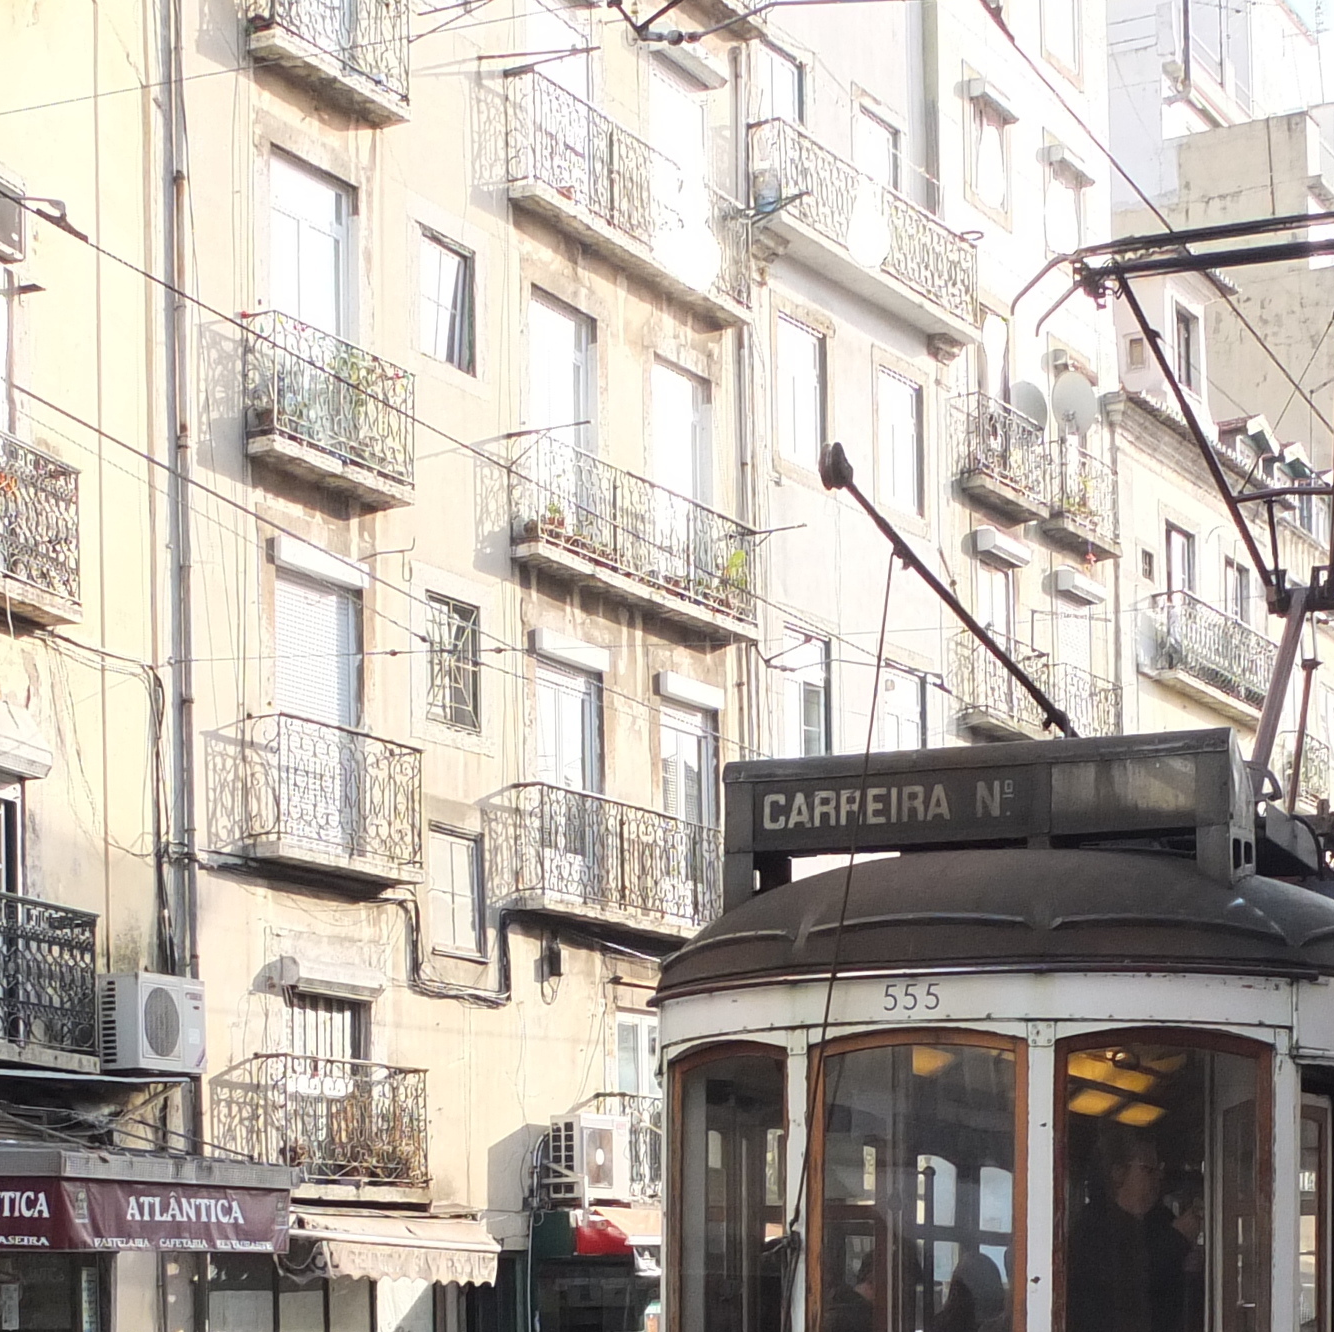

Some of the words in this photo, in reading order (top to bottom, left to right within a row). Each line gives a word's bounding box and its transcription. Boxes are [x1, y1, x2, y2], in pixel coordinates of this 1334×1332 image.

[762, 783, 951, 830] CARREIRA
[883, 983, 941, 1012] 555
[125, 1190, 246, 1225] ATLÂNTICA
